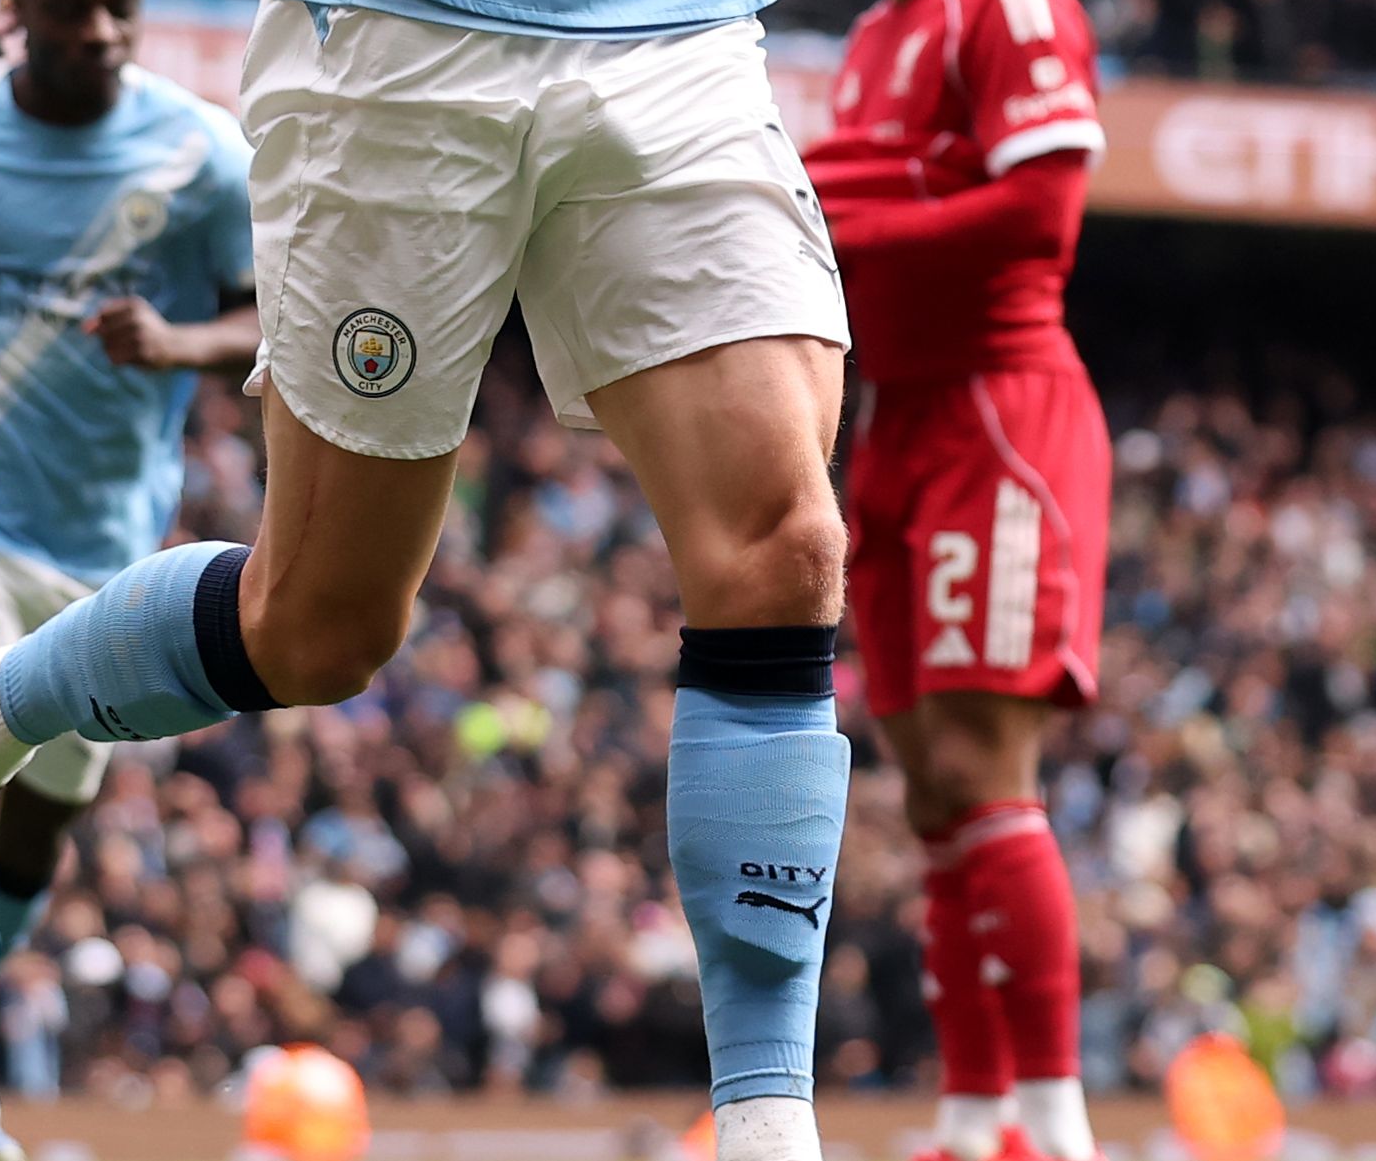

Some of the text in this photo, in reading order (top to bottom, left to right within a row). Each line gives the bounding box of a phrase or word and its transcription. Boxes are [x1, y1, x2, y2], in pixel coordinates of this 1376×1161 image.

[343, 315, 407, 345] MANCHESTER
[358, 381, 383, 391] CITY
[928, 530, 978, 622] 2
[740, 862, 826, 881] CITY
